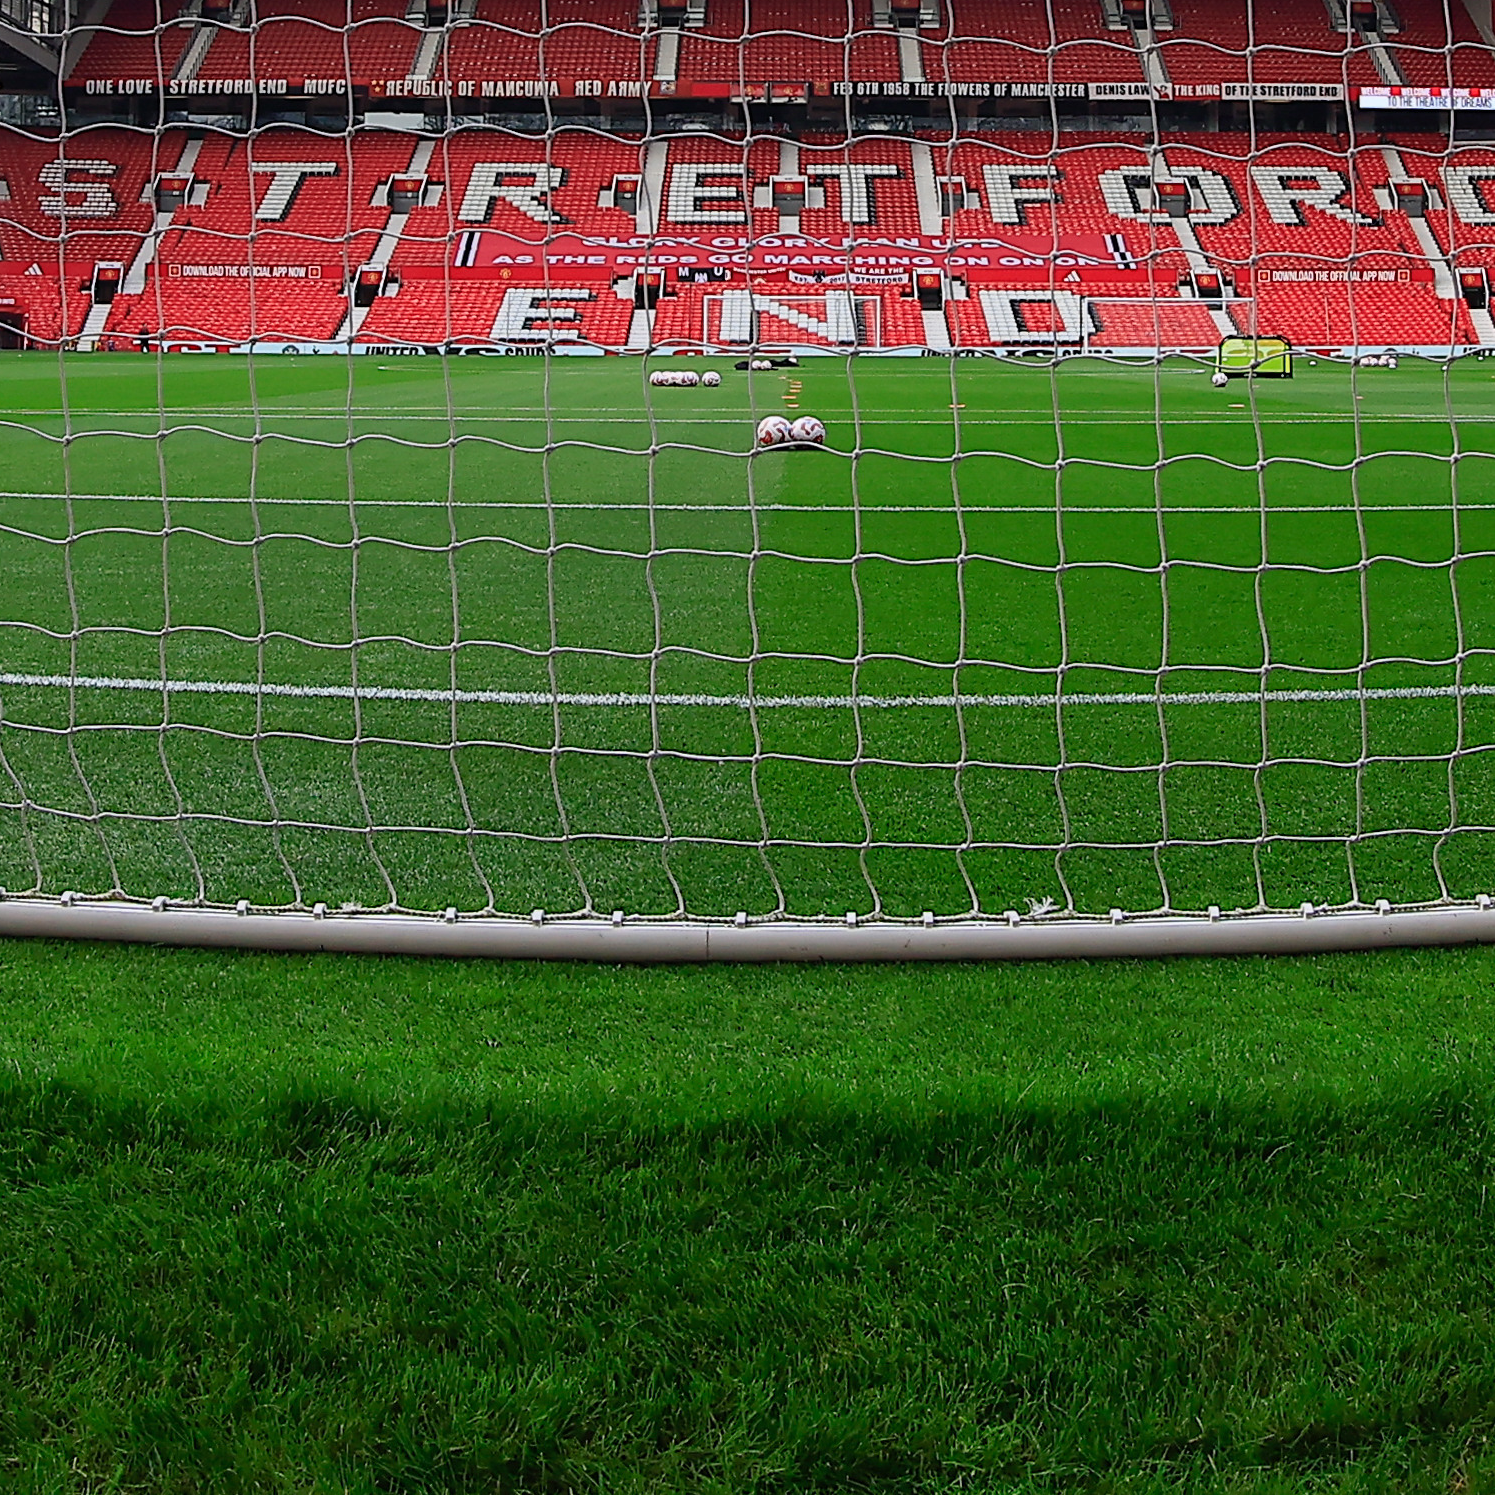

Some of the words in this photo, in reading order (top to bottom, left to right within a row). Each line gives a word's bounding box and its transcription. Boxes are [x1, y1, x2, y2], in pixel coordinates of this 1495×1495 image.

[85, 79, 114, 95] ONE
[117, 78, 153, 95] LOVE
[169, 78, 254, 95] STRETFORD
[258, 78, 288, 95] END
[303, 78, 347, 95] MUFC
[457, 79, 477, 97] OF
[832, 82, 854, 96] FEB
[856, 82, 879, 95] 6TH
[882, 82, 910, 96] 1958
[914, 82, 935, 96] THE
[938, 82, 991, 97] FLOWERS
[993, 82, 1008, 97] OF
[1010, 82, 1085, 97] MANCHESTER
[1095, 83, 1126, 96] DENIS
[1128, 84, 1151, 96] LAW
[1173, 83, 1195, 97] THE
[1195, 83, 1220, 97] KING
[1224, 84, 1238, 97] OF
[1239, 85, 1258, 97] THE
[1259, 85, 1317, 97] STRETFORD
[1318, 86, 1338, 97] END
[1387, 95, 1397, 107] TO
[1399, 95, 1413, 107] THE
[1415, 95, 1448, 107] THEATRE
[1461, 97, 1492, 108] DREAMS
[711, 237, 830, 248] GLORY
[841, 238, 919, 248] MAN
[492, 255, 534, 264] AS
[545, 255, 606, 264] THE
[616, 255, 698, 265] REDS
[707, 255, 754, 265] GO
[763, 255, 934, 266] MARCHING
[943, 256, 989, 266] ON
[998, 256, 1044, 266] ON
[1053, 256, 1099, 267] ON
[182, 264, 224, 277] DOWNLOAD
[224, 265, 238, 277] THE
[272, 266, 287, 278] APP
[287, 266, 306, 278] NOW
[1272, 270, 1313, 281] DOWNLOAD
[1314, 270, 1329, 281] THE
[1329, 270, 1361, 281] OFFICAL
[1362, 270, 1377, 281] APP
[1378, 270, 1395, 281] NOW
[829, 276, 845, 284] 2017
[855, 276, 904, 284] STRETFORD
[490, 287, 1097, 346] END
